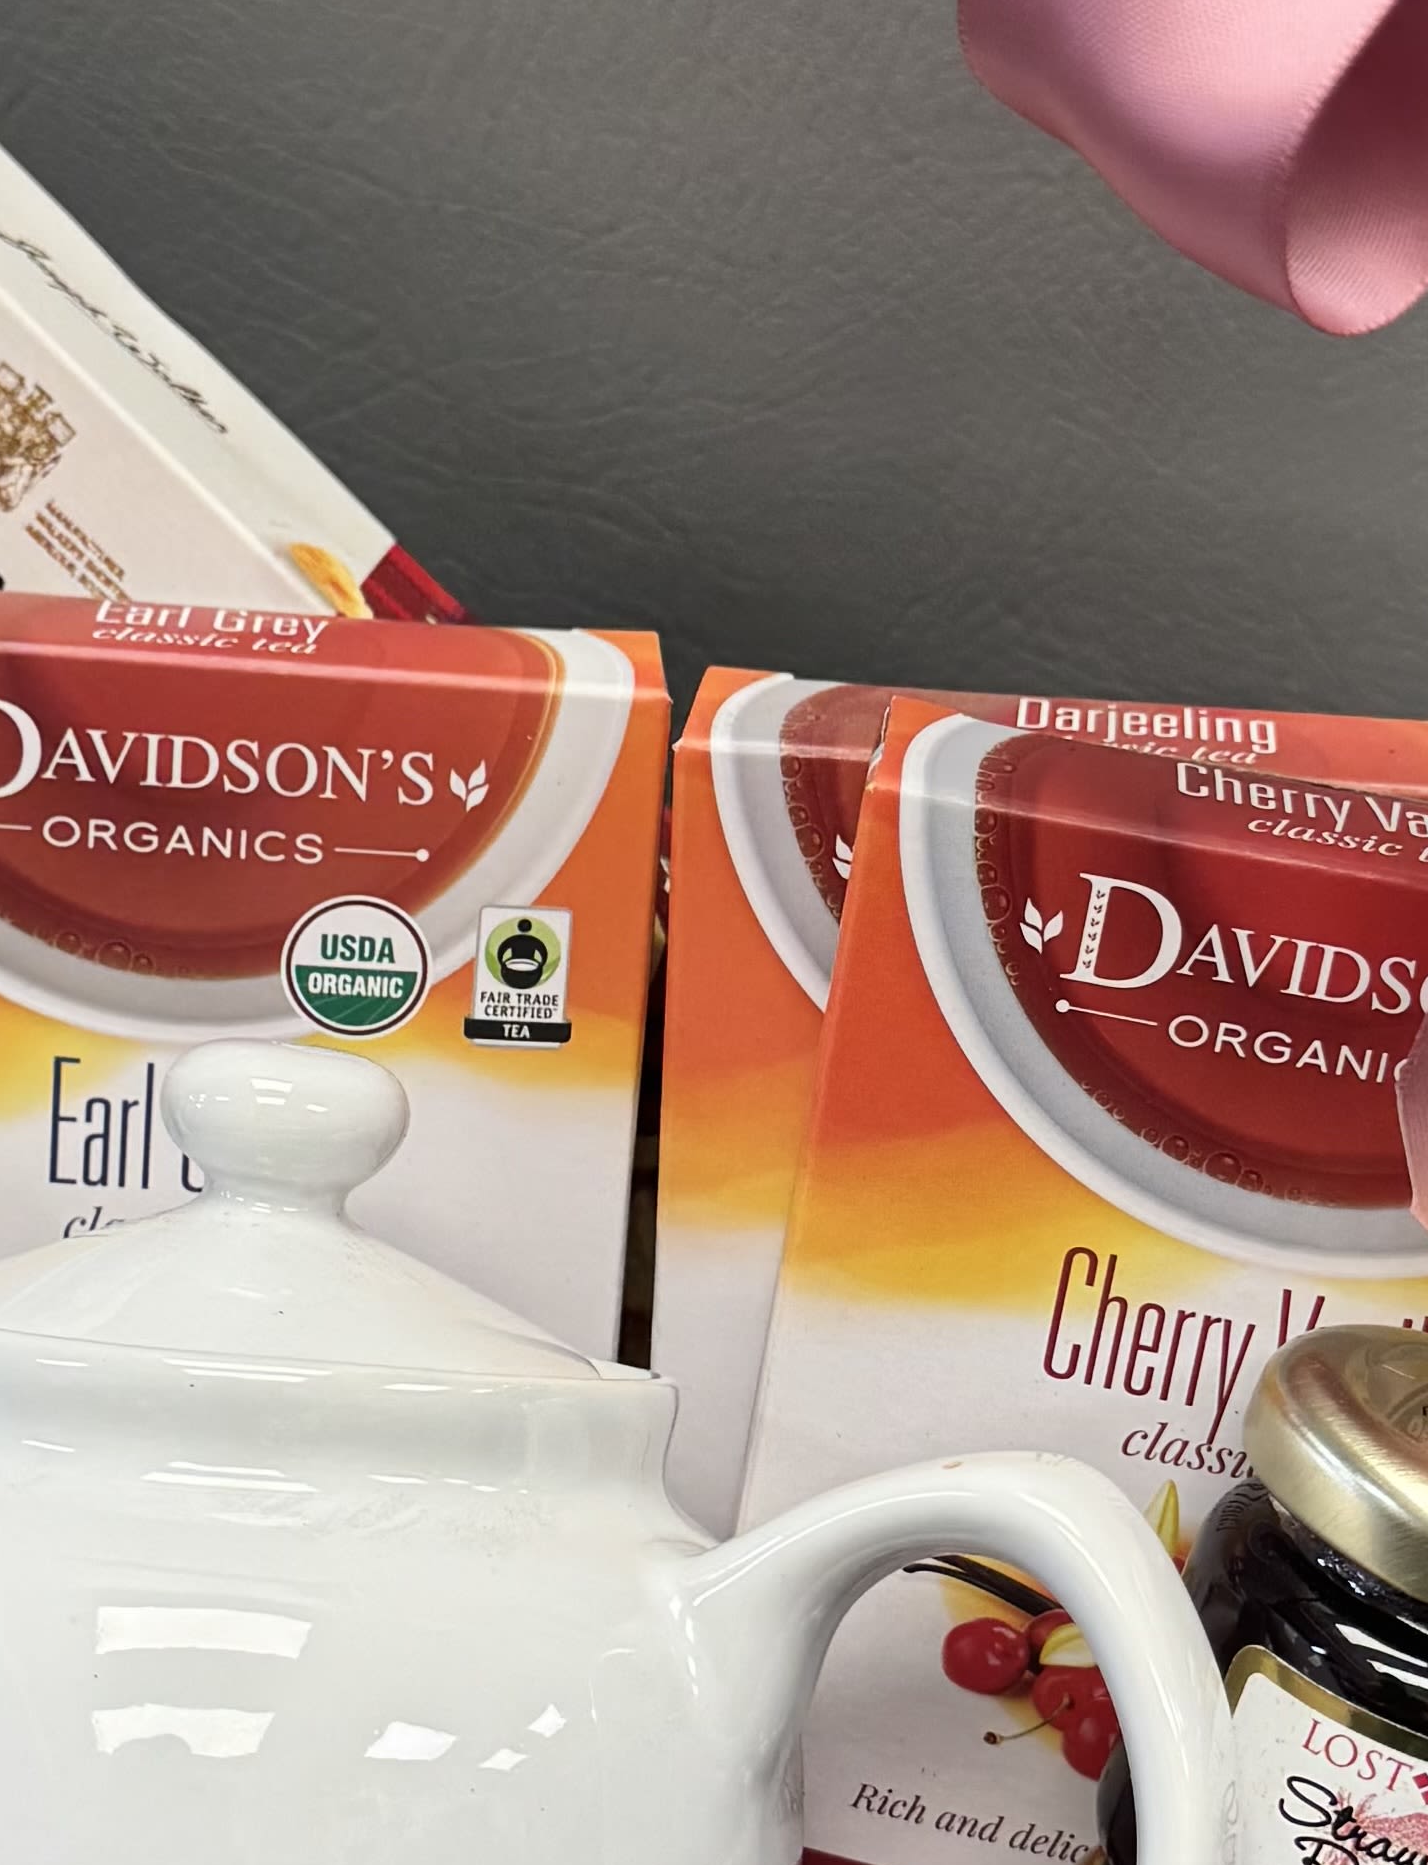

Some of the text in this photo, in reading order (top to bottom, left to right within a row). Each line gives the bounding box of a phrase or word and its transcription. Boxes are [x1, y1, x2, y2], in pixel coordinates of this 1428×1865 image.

[92, 625, 318, 656] classic tea
[95, 600, 329, 645] Earl Grey
[1016, 697, 1279, 755] Darjeeling
[1192, 744, 1259, 766] tea
[1175, 761, 1353, 834] Cherry
[42, 814, 325, 865] ORGANICS
[1247, 816, 1403, 857] classic
[319, 933, 397, 965] USDA
[307, 971, 405, 1000] ORGANIC
[480, 991, 560, 1008] FAIR TRADE
[502, 1023, 531, 1040] TEA
[1168, 1014, 1409, 1084] ORGANI
[49, 1055, 155, 1190] Earl
[1043, 1246, 1257, 1445] Cherry
[1121, 1421, 1255, 1480] classi
[1301, 1718, 1414, 1792] LOST
[849, 1782, 1090, 1864] Rich and delic
